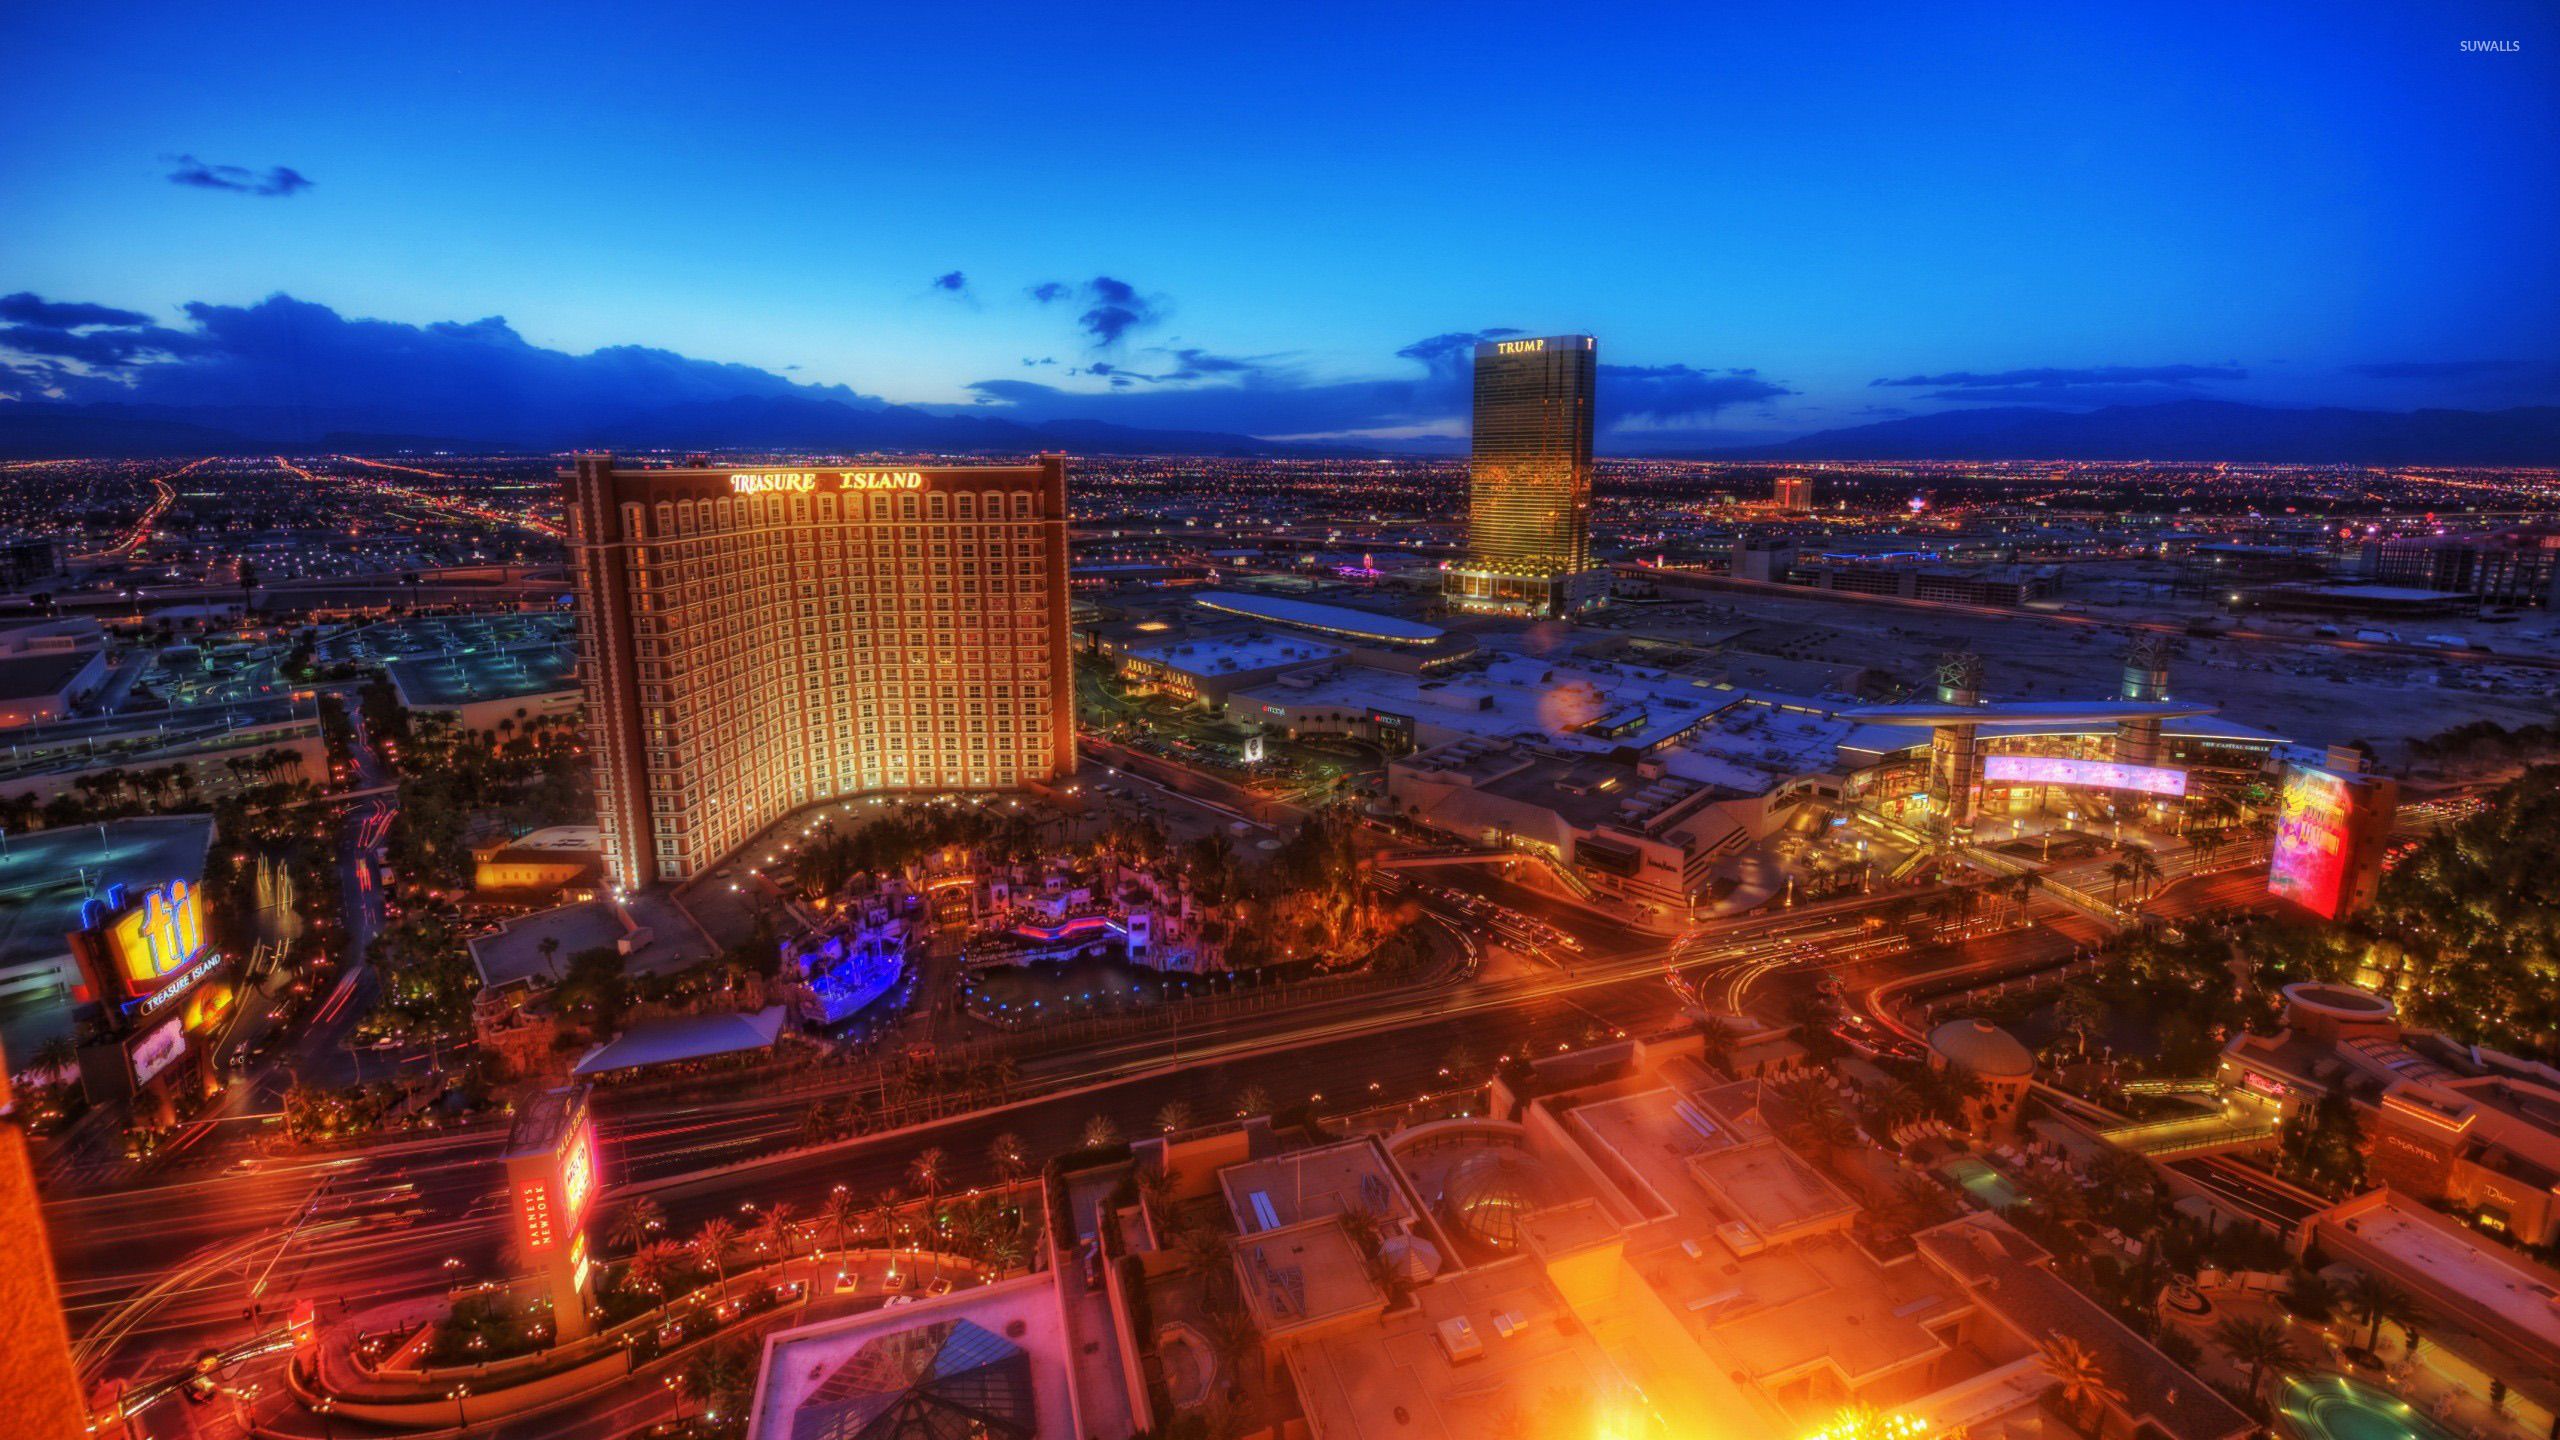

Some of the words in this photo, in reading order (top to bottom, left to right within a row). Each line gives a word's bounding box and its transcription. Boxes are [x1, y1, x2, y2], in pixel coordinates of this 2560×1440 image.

[1498, 339, 1544, 355] TRUMP
[730, 473, 816, 494] TREASURE
[839, 472, 922, 489] ISLAND
[142, 878, 198, 975] ti
[147, 975, 190, 1011] TREASURE
[191, 953, 222, 983] ISLAND
[2386, 1136, 2440, 1164] CHANEL
[523, 1188, 541, 1247] BARNEYS
